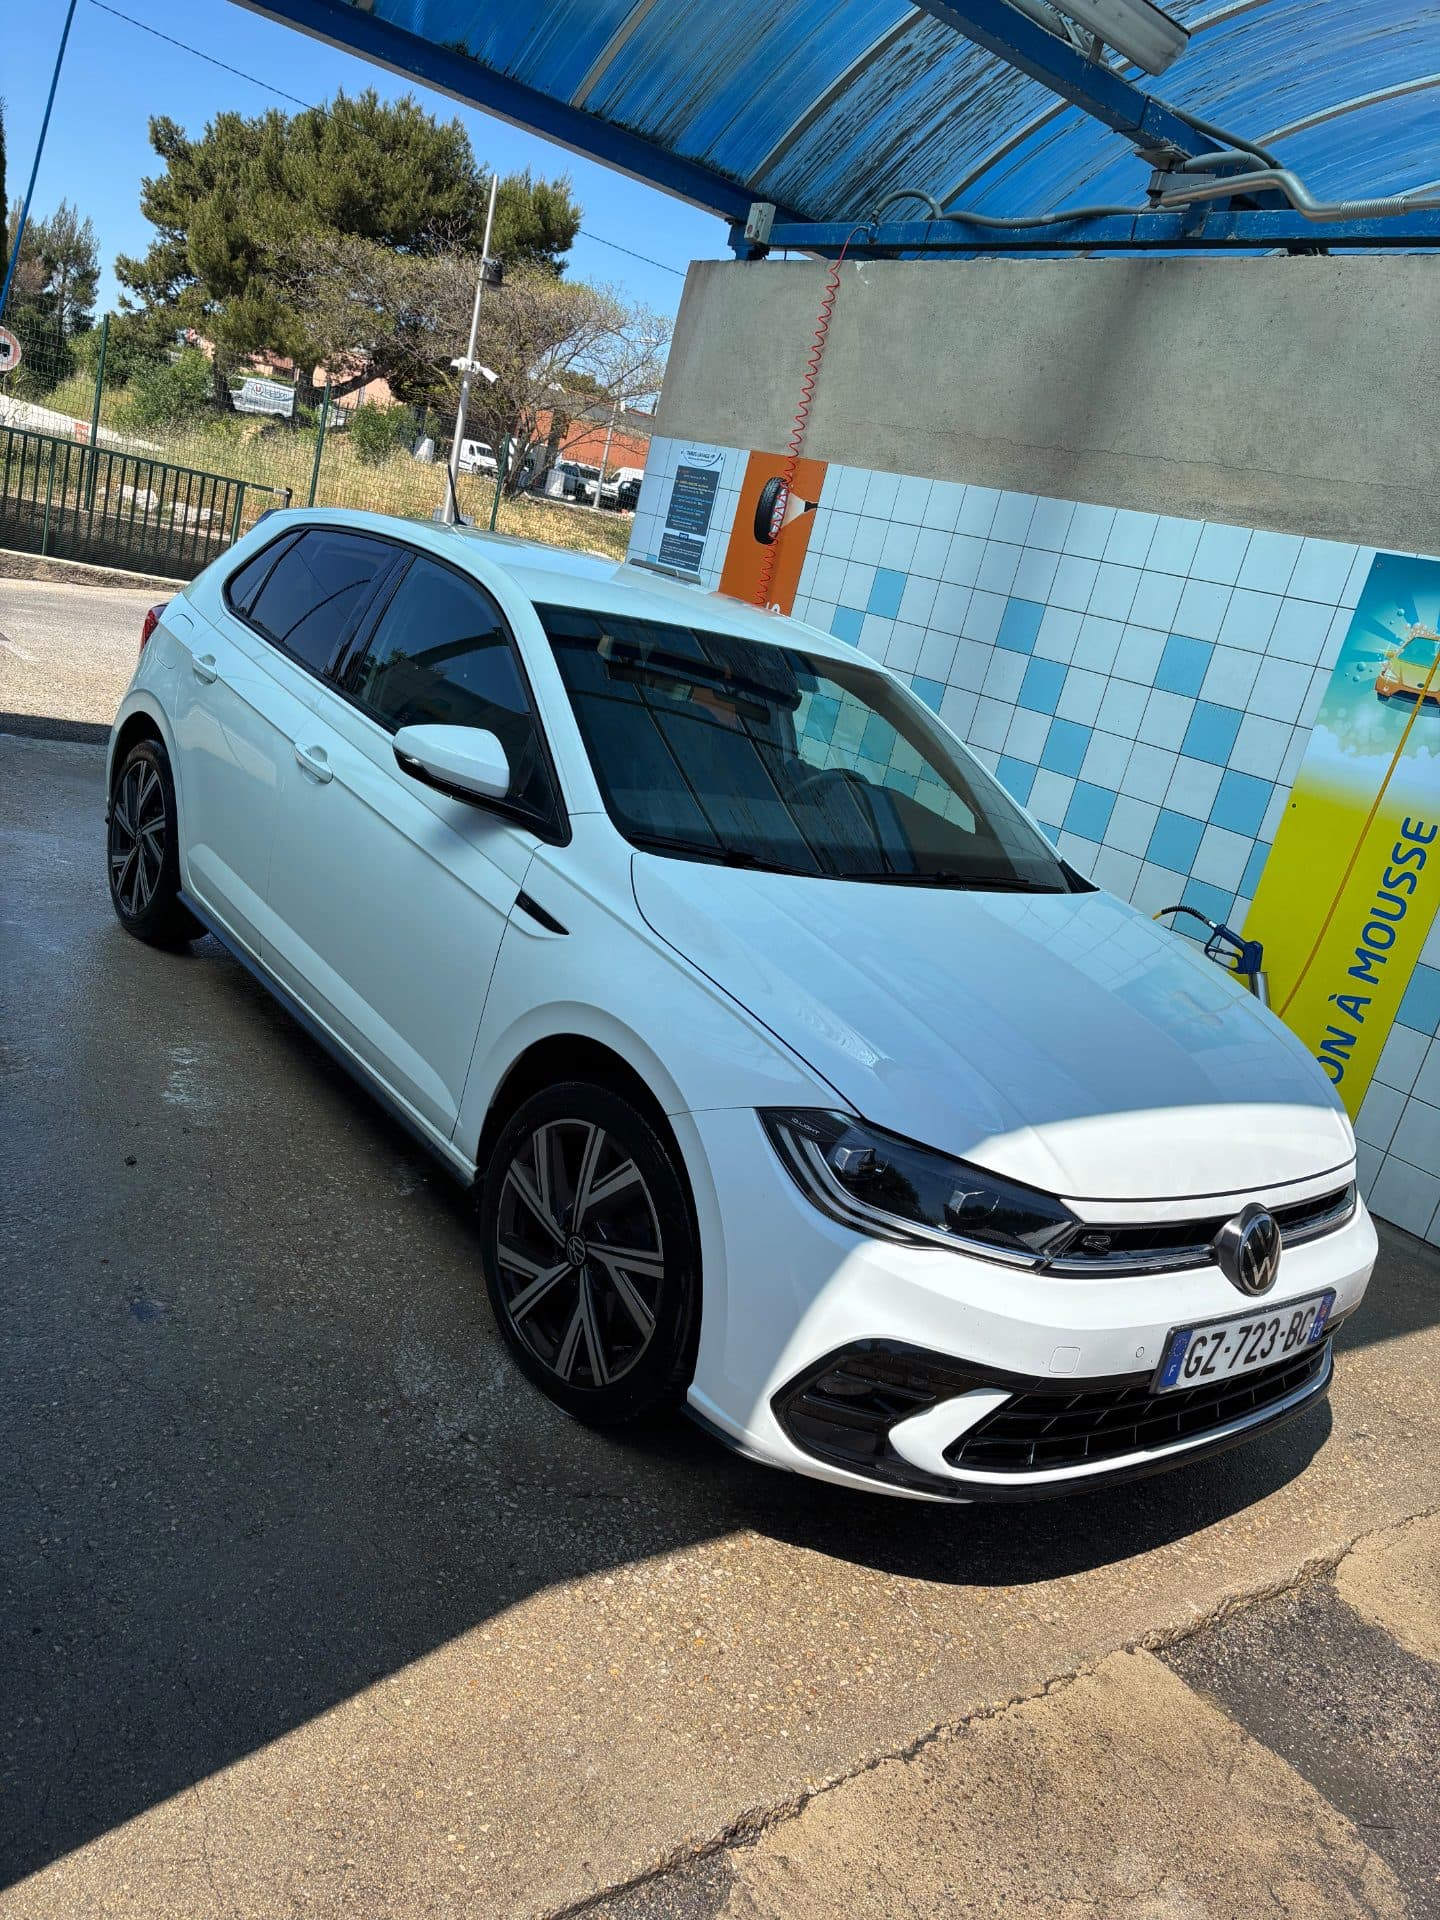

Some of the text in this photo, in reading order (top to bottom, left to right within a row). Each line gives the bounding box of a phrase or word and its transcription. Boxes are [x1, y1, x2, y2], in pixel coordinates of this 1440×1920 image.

[1348, 816, 1439, 985] MOUSSE
[1327, 993, 1372, 1024] À
[1168, 1364, 1175, 1377] F
